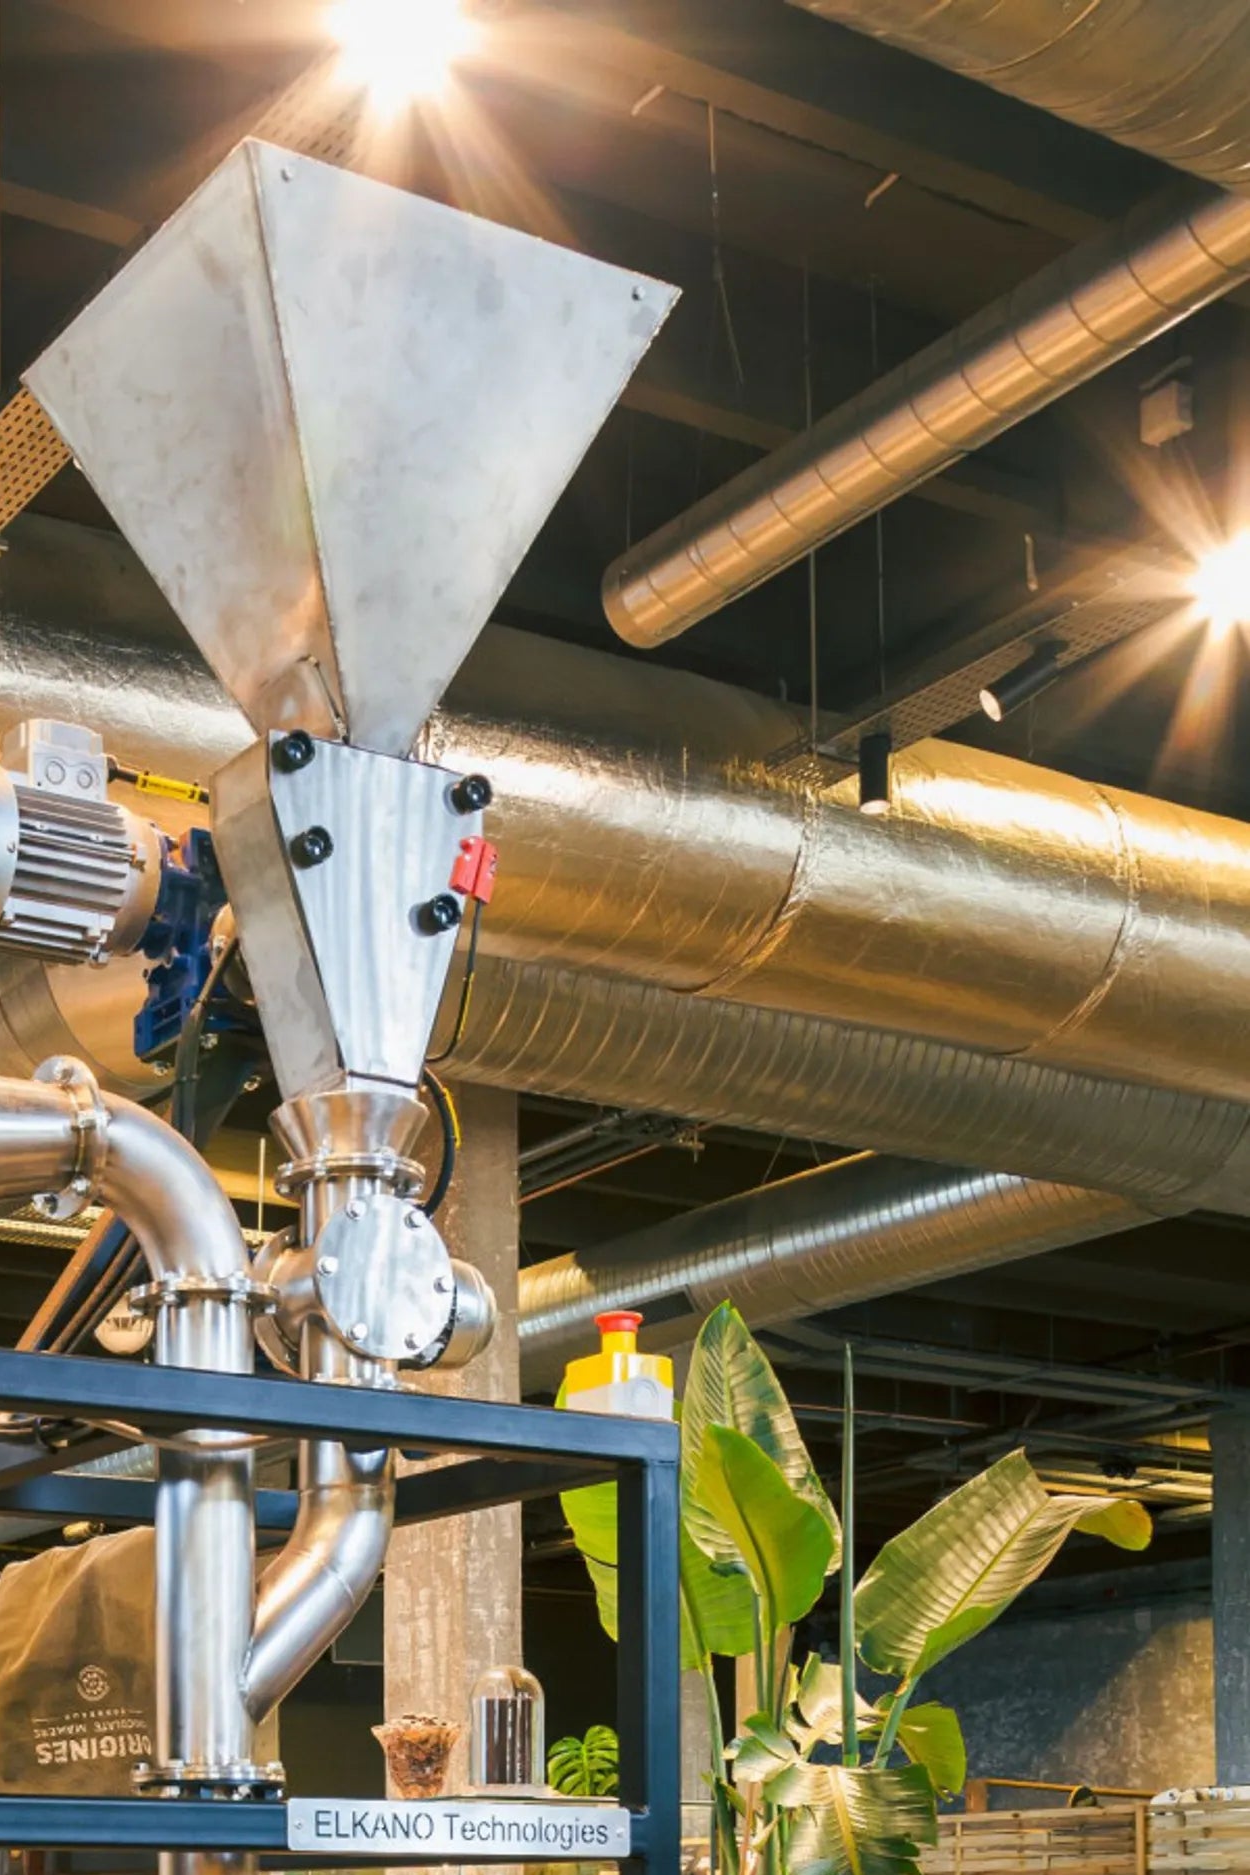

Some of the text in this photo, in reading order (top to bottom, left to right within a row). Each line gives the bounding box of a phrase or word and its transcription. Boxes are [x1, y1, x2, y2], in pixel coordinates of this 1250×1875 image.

[93, 1718, 148, 1733] COLATE
[34, 1733, 152, 1765] ORIGINES
[313, 1809, 610, 1851] ELKANO Technologies
